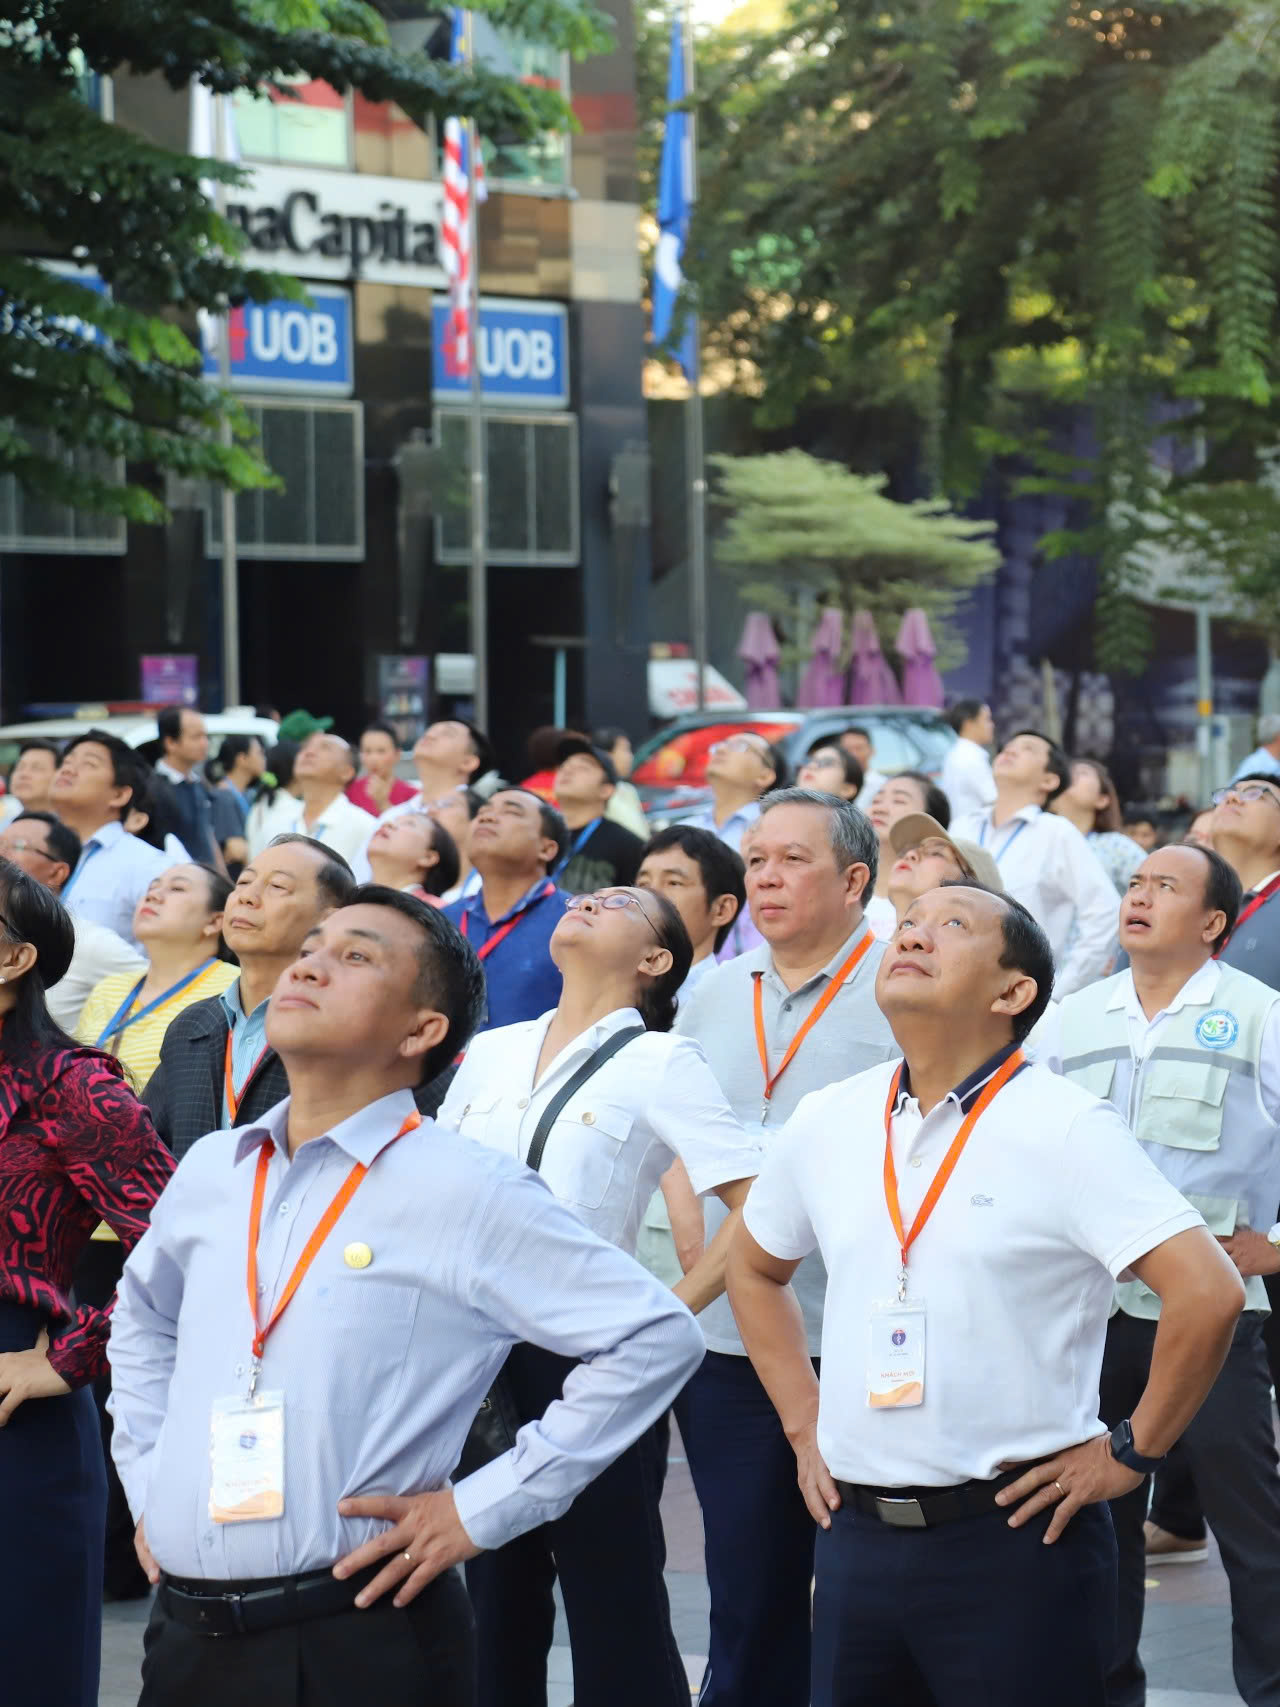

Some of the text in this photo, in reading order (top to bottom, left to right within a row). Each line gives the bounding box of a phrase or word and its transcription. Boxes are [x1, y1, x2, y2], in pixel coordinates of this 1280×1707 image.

[226, 191, 443, 280] naCapita
[252, 308, 338, 366] UOB
[477, 326, 556, 380] UOB
